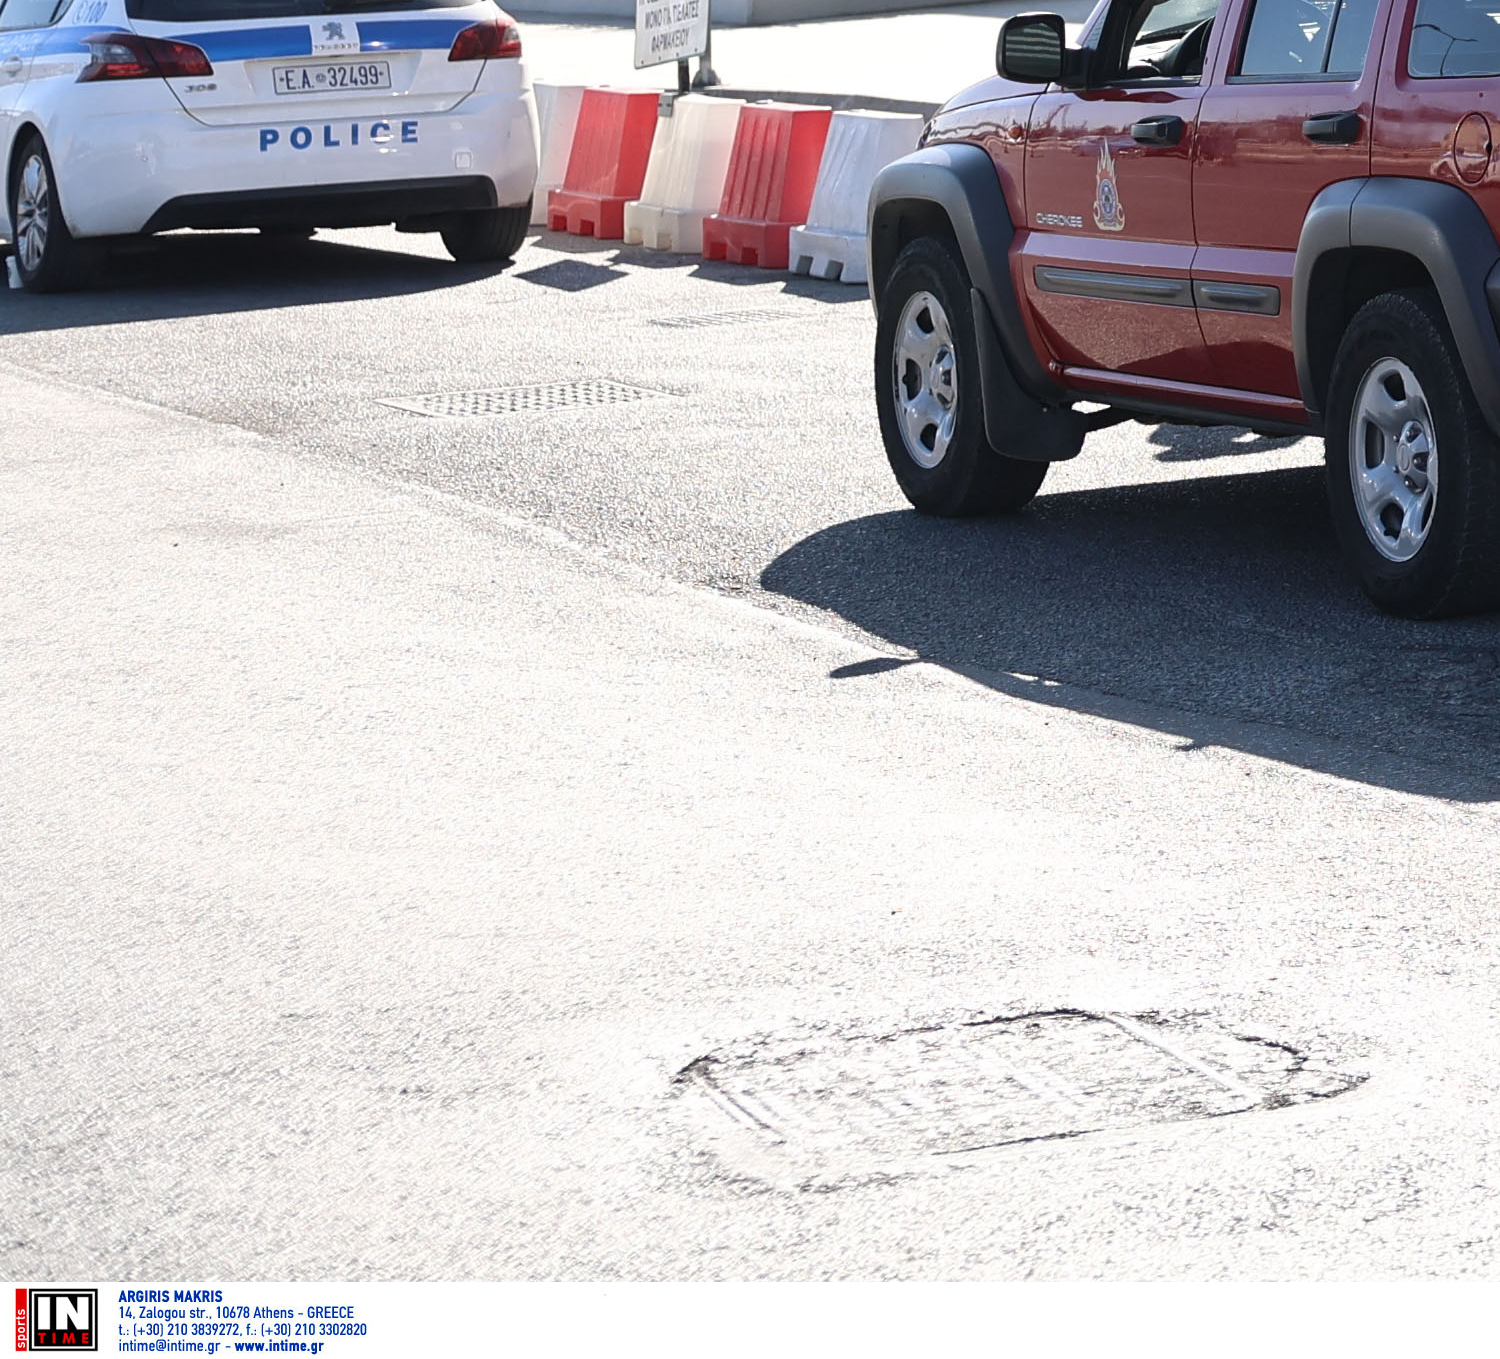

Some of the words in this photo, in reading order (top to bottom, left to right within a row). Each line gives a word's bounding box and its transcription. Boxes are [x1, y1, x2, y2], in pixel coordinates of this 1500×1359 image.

[328, 67, 381, 88] 32499
[259, 120, 420, 152] POLICE
[1036, 212, 1083, 228] CHEROKEE
